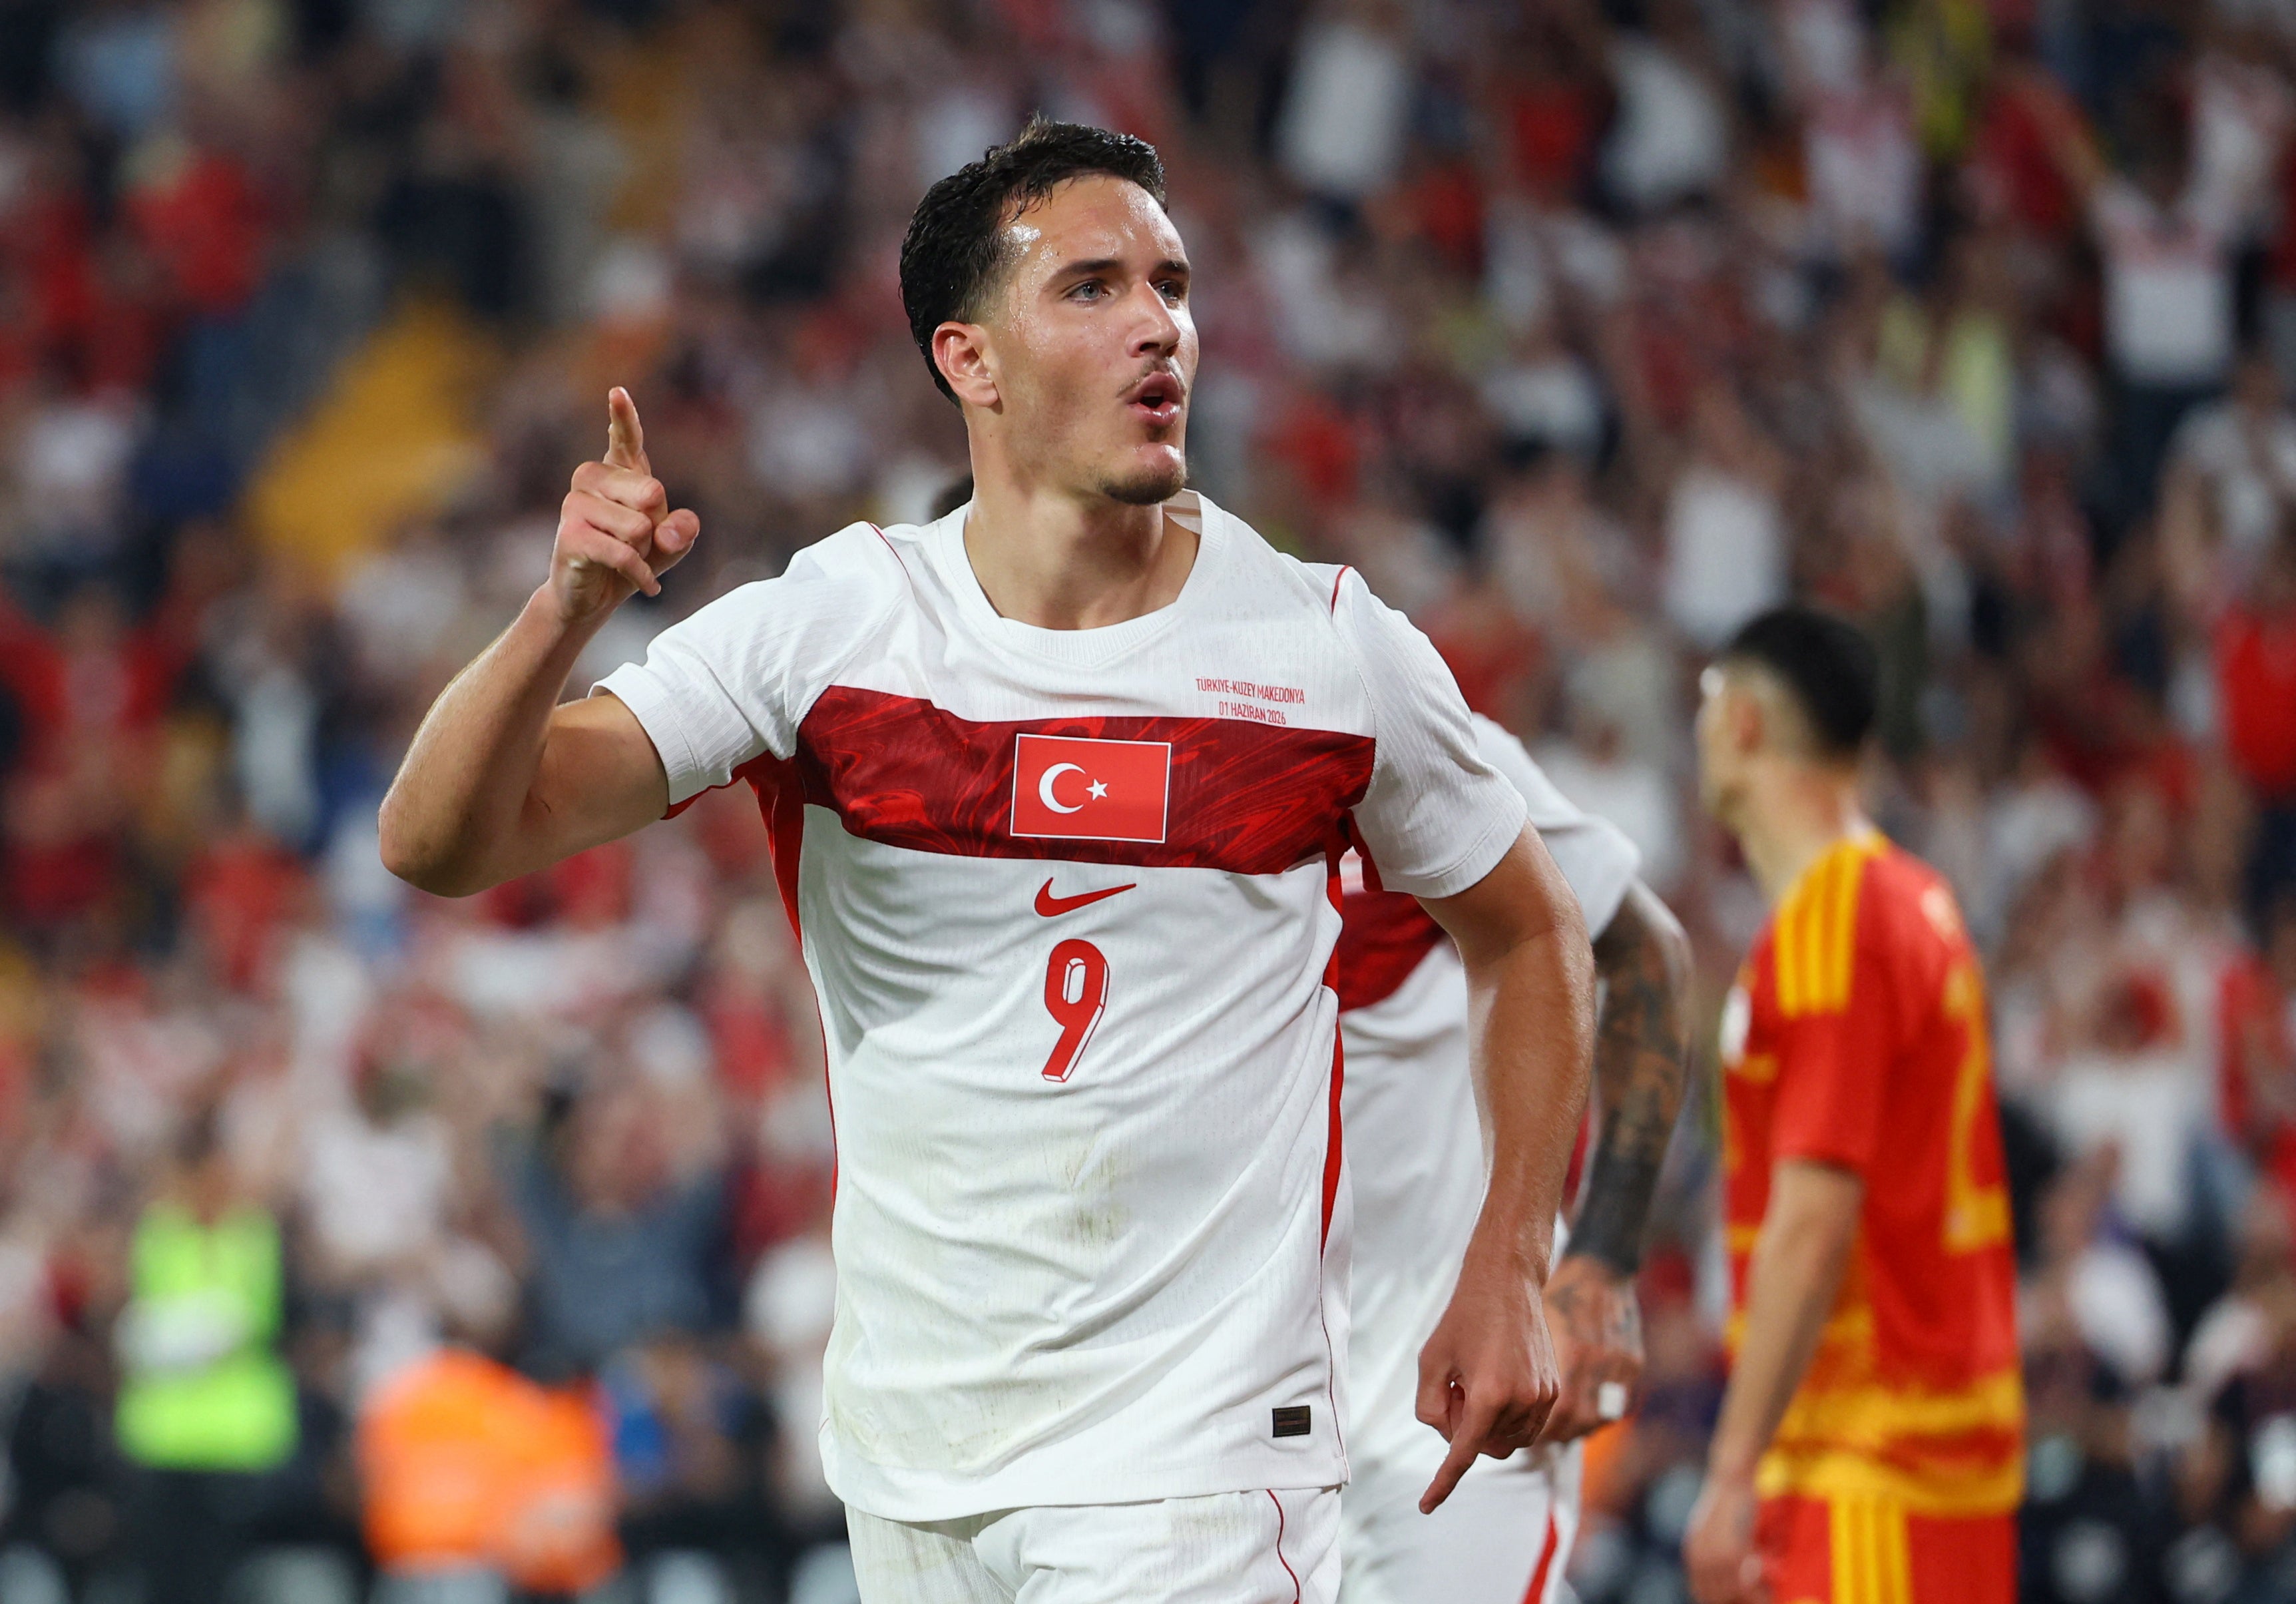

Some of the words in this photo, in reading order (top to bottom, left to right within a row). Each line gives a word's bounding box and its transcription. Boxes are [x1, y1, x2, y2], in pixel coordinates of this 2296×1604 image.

[1196, 676, 1256, 697] TÜRKİYE-KUZEY
[1257, 685, 1305, 704] MAKEDONYA
[1219, 701, 1228, 715] 01
[1232, 702, 1265, 721] HAZİRAN
[1267, 709, 1286, 724] 2026
[1041, 938, 1110, 1083] 9
